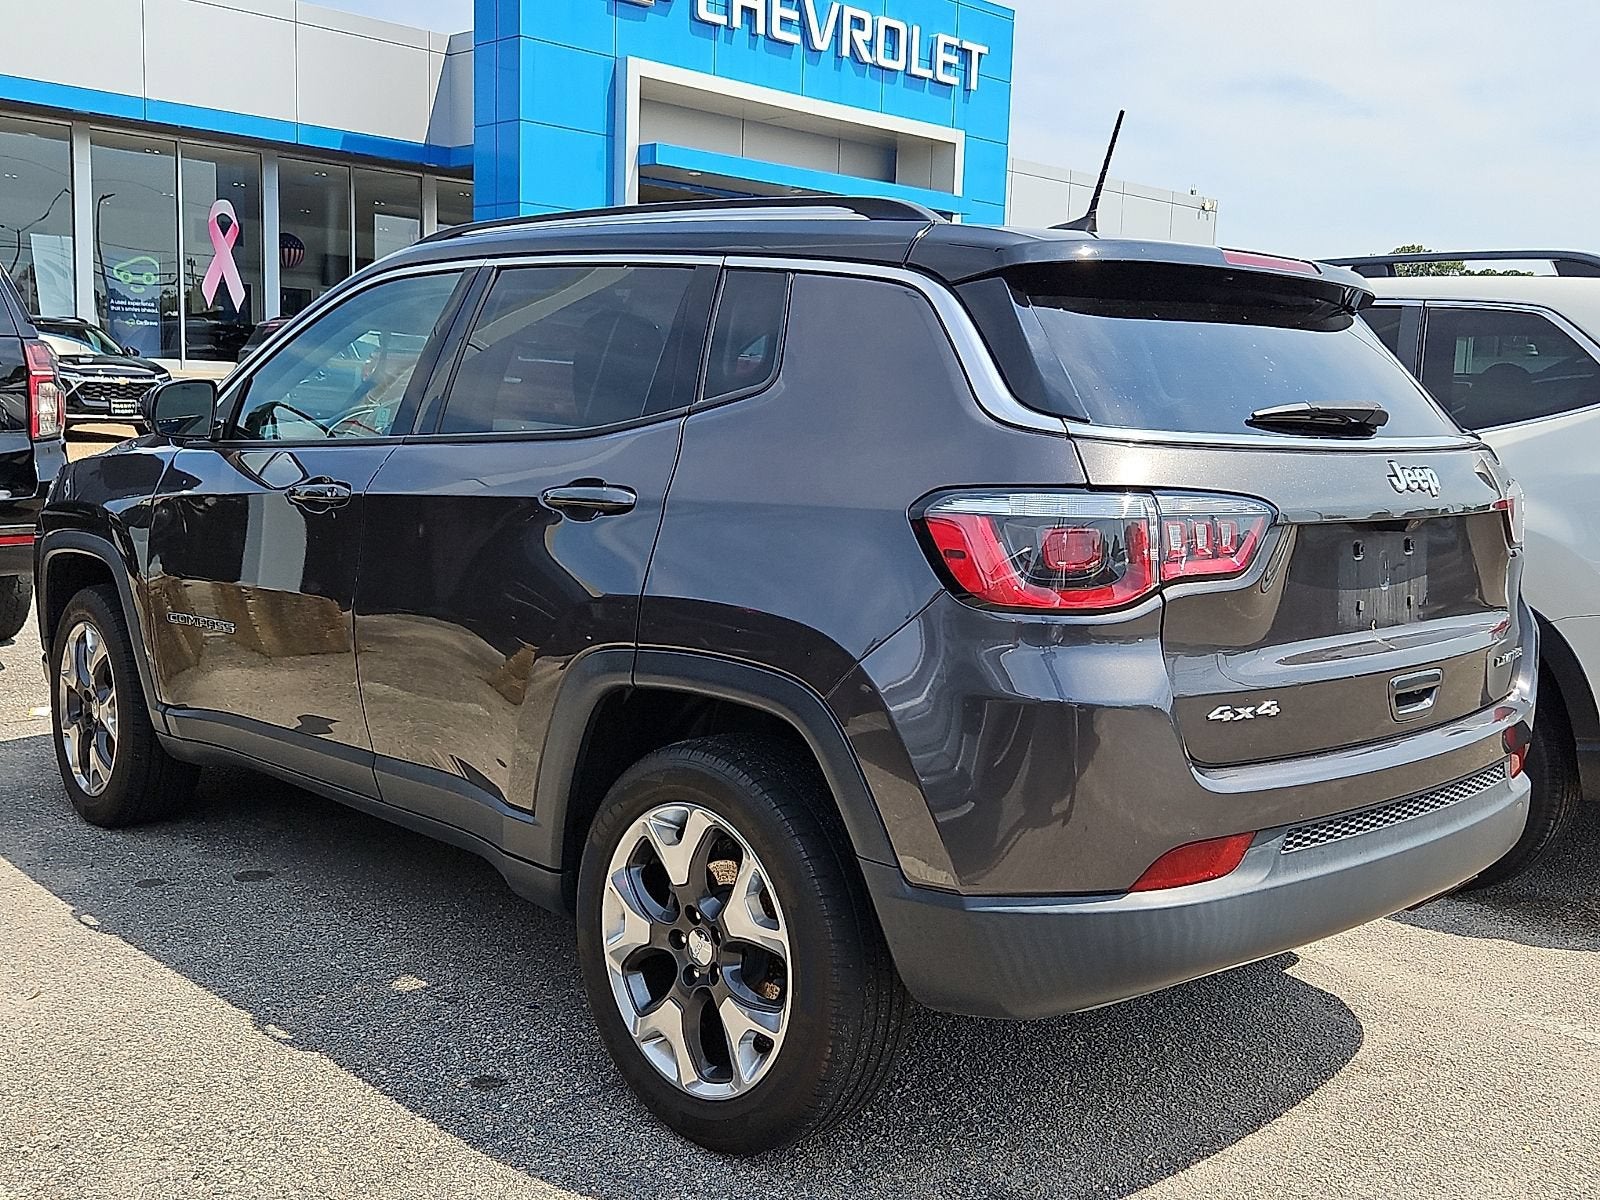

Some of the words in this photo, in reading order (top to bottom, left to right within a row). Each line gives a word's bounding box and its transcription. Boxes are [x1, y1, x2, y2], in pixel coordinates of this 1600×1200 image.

[1386, 459, 1441, 499] Jeep
[167, 612, 236, 634] COMPASS
[1206, 700, 1281, 722] 4x4
